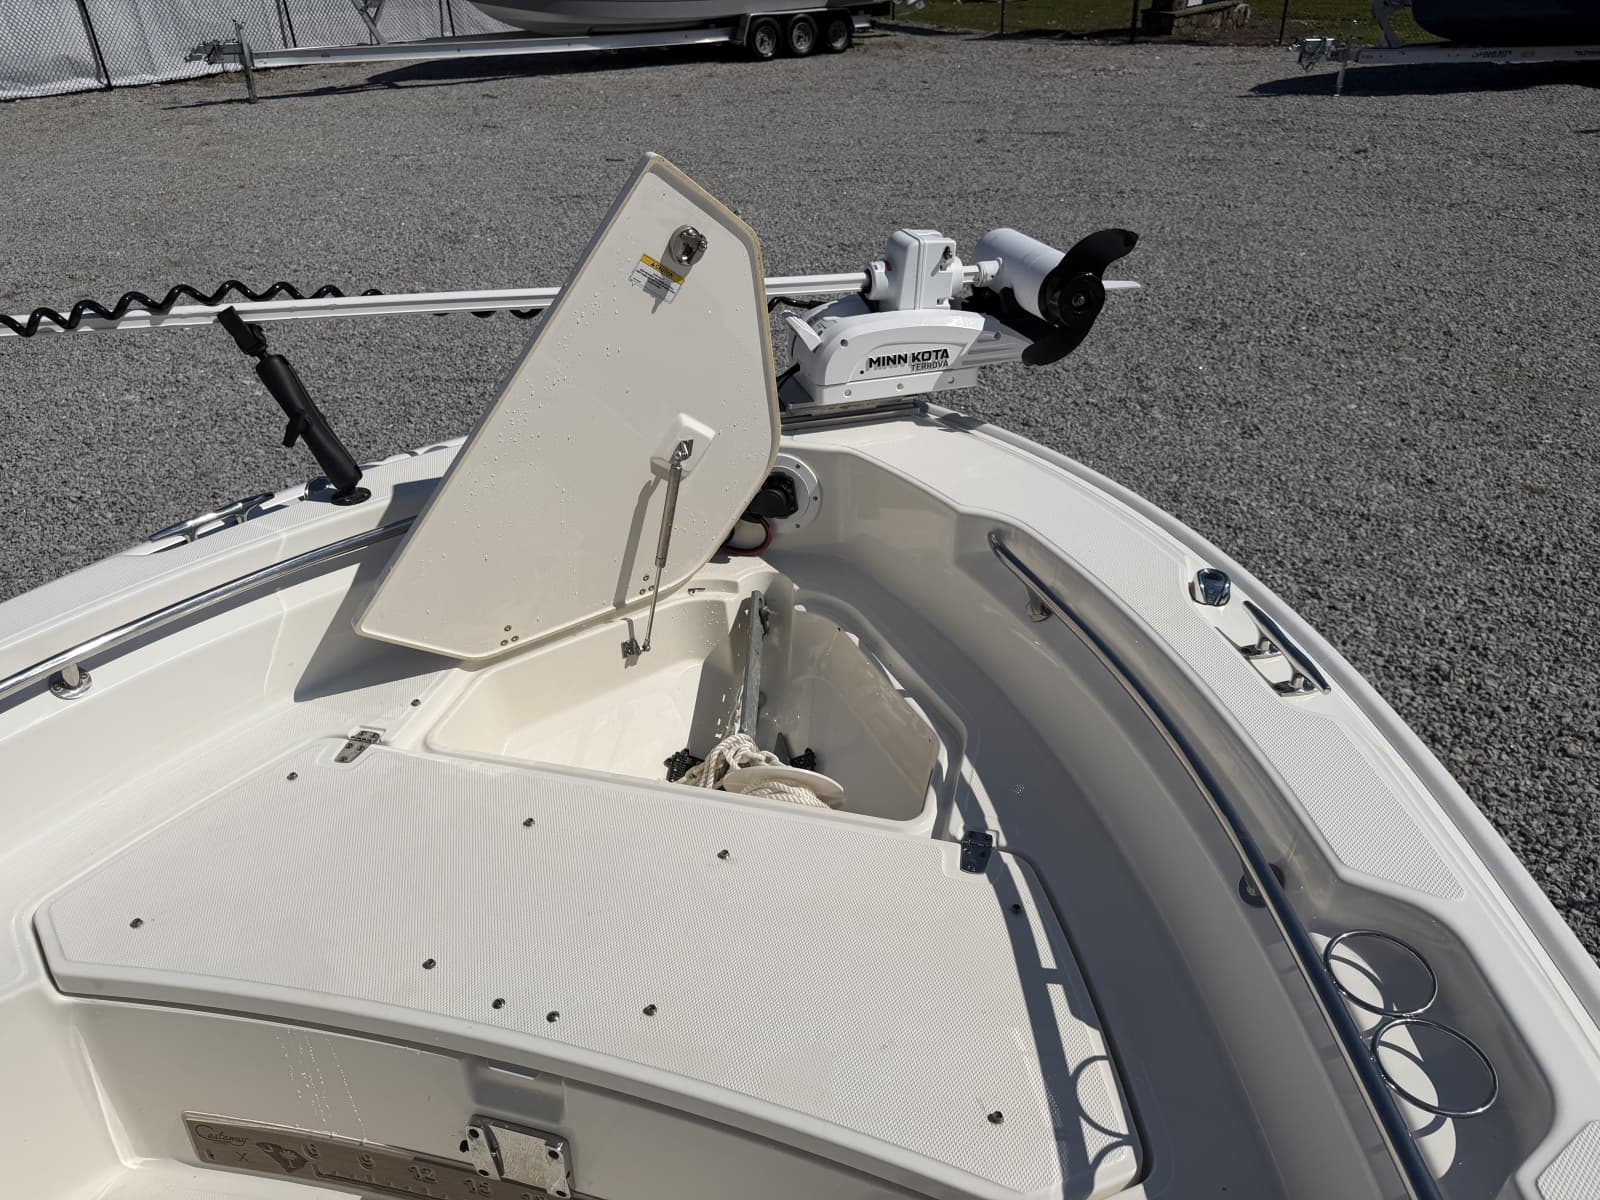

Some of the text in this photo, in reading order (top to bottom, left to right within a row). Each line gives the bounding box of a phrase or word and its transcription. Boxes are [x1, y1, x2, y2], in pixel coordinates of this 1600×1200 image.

[868, 348, 950, 369] MINN KOTA
[911, 360, 949, 372] TERROVA
[408, 1166, 438, 1183] 12
